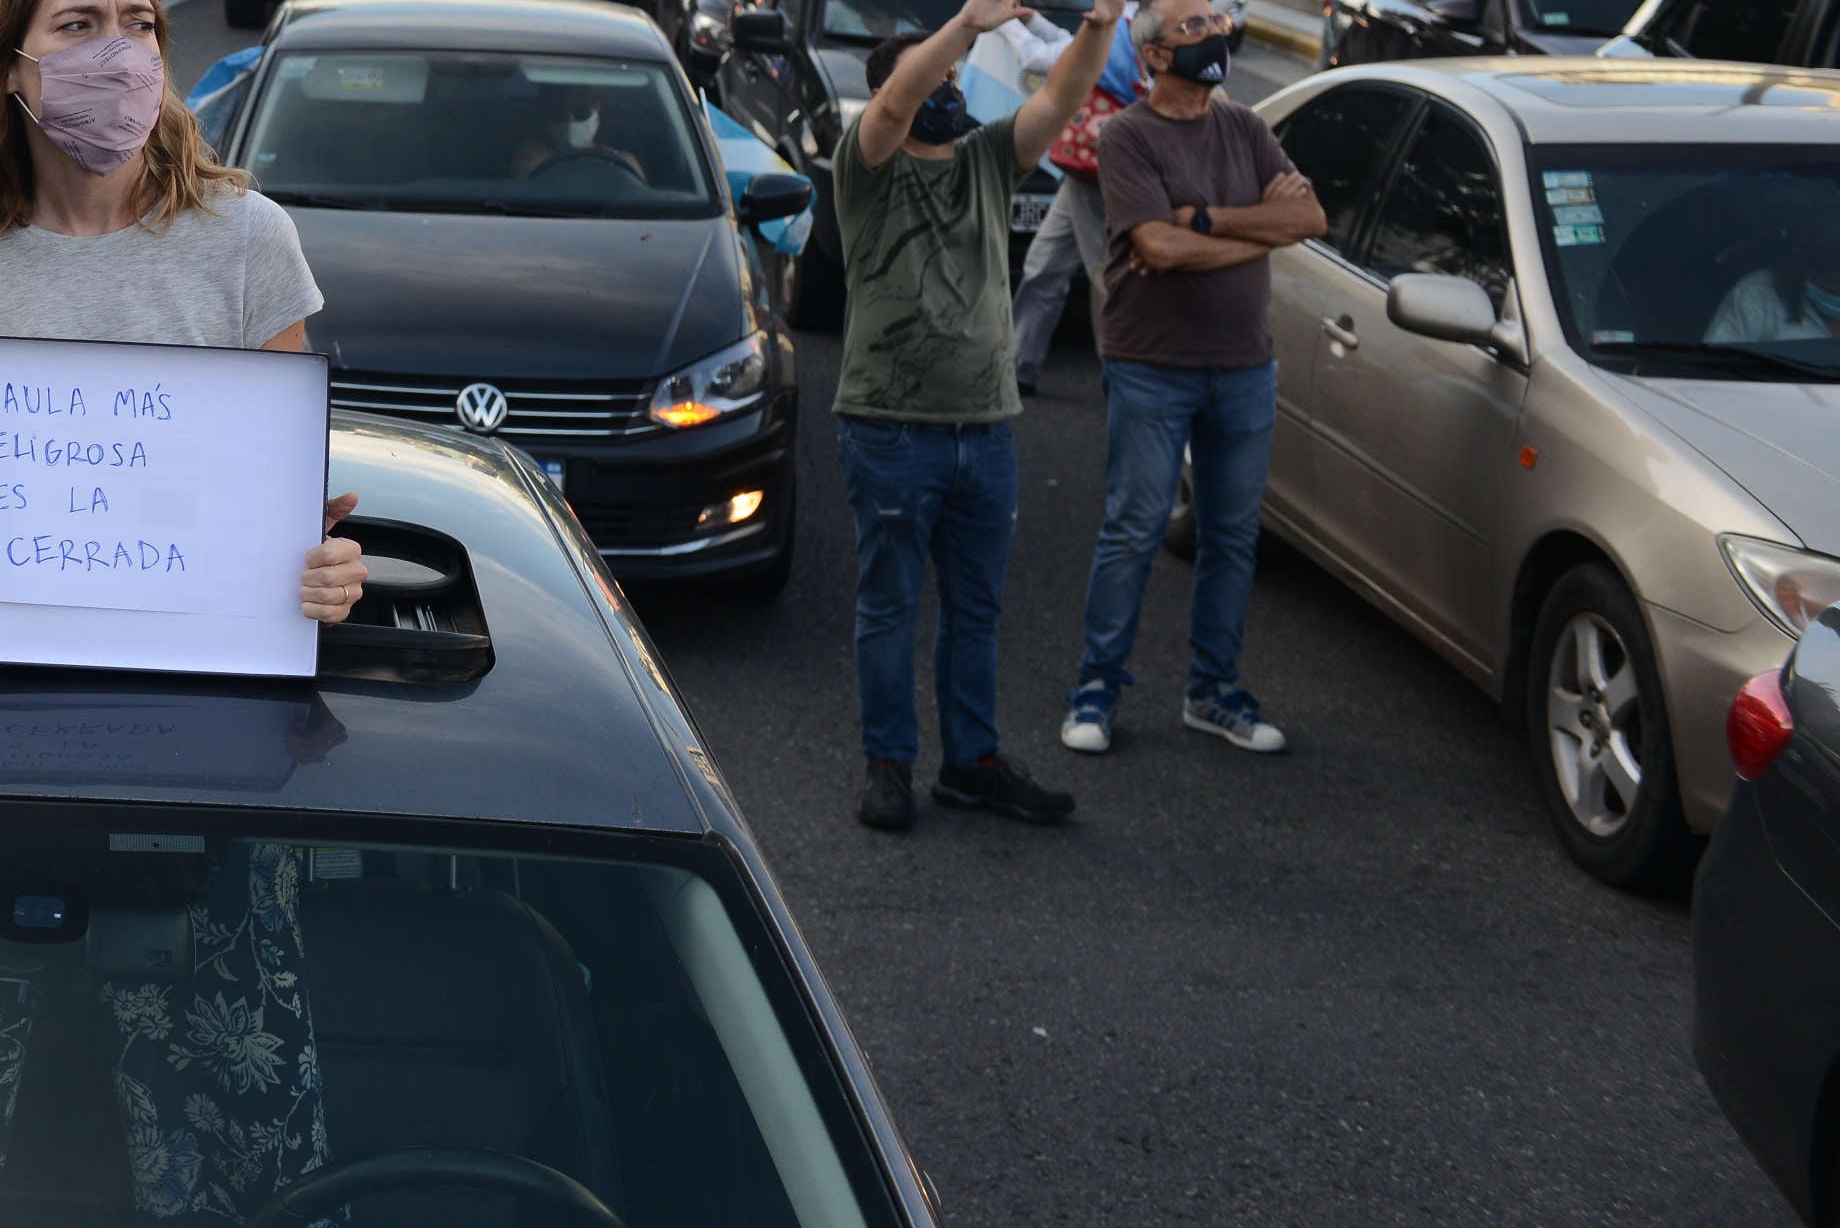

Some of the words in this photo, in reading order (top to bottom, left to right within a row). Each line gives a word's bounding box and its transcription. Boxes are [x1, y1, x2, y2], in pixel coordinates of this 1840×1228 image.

[3, 382, 87, 416] AULA
[113, 383, 173, 420] MÁS
[69, 486, 109, 513] LA
[6, 535, 186, 572] CERRADA
